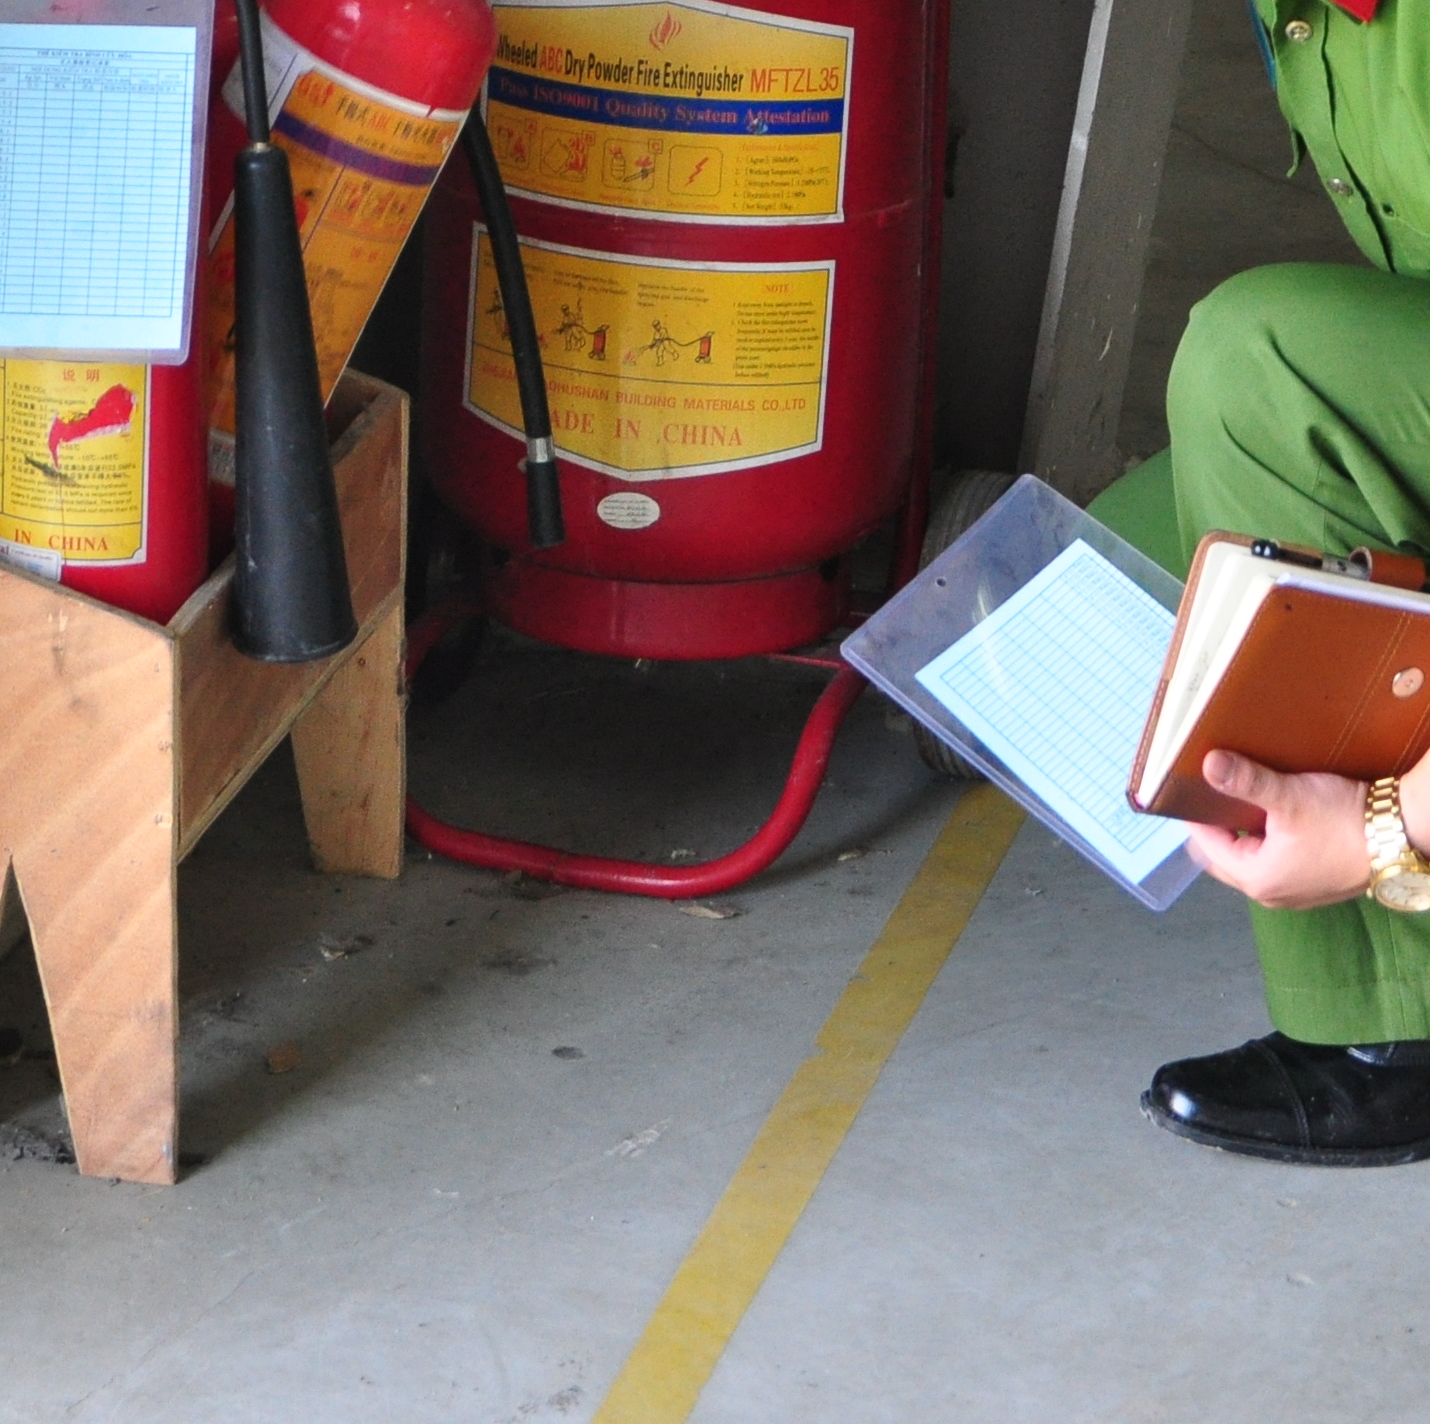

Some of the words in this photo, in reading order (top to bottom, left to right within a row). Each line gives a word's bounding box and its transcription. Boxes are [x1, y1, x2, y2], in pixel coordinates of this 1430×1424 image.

[497, 35, 538, 68] Wheeled
[540, 45, 563, 73] ABC
[565, 49, 585, 82] Dry
[587, 52, 633, 83] Powder
[636, 59, 660, 87] Fire
[664, 61, 744, 95] Extinguisher
[751, 67, 839, 93] MFTZL35
[533, 80, 598, 111] ISO9001
[605, 97, 668, 122] Quality
[675, 106, 738, 125] System
[745, 107, 830, 124] Attestation
[62, 368, 100, 382] 说明
[548, 380, 609, 401] OHUSHAN
[616, 390, 676, 408] BUILDING
[684, 398, 754, 411] MATERIALS
[762, 398, 806, 411] CO.,LTD
[550, 408, 595, 434] ADE
[613, 418, 641, 440] IN
[663, 423, 743, 446] CHINA
[14, 528, 31, 544] IN
[48, 535, 109, 552] CHINA
